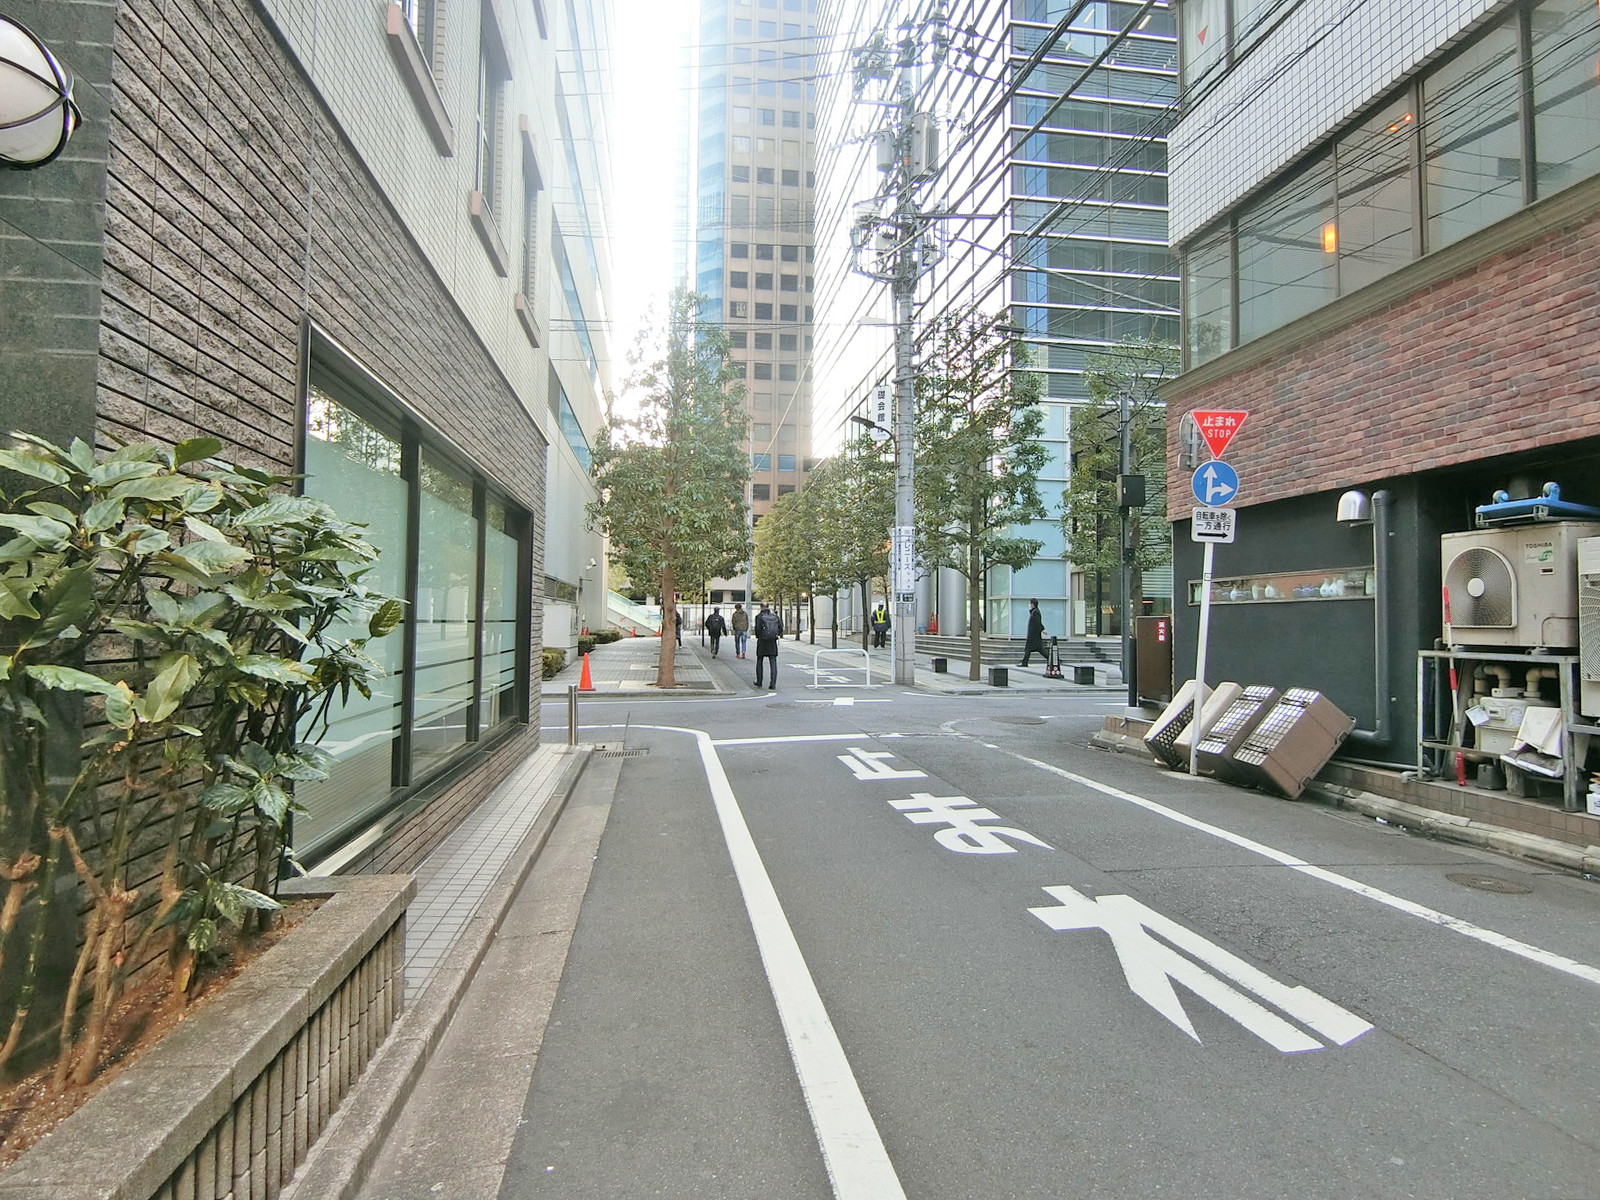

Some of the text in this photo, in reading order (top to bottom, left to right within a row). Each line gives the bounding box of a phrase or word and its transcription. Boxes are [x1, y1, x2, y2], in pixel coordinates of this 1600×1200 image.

[1203, 416, 1236, 427] 止まれ
[1207, 429, 1231, 438] STOP
[1195, 511, 1231, 521] 自転車を除く
[1195, 521, 1231, 531] 一方通行
[836, 747, 1375, 1053] 止まれ
